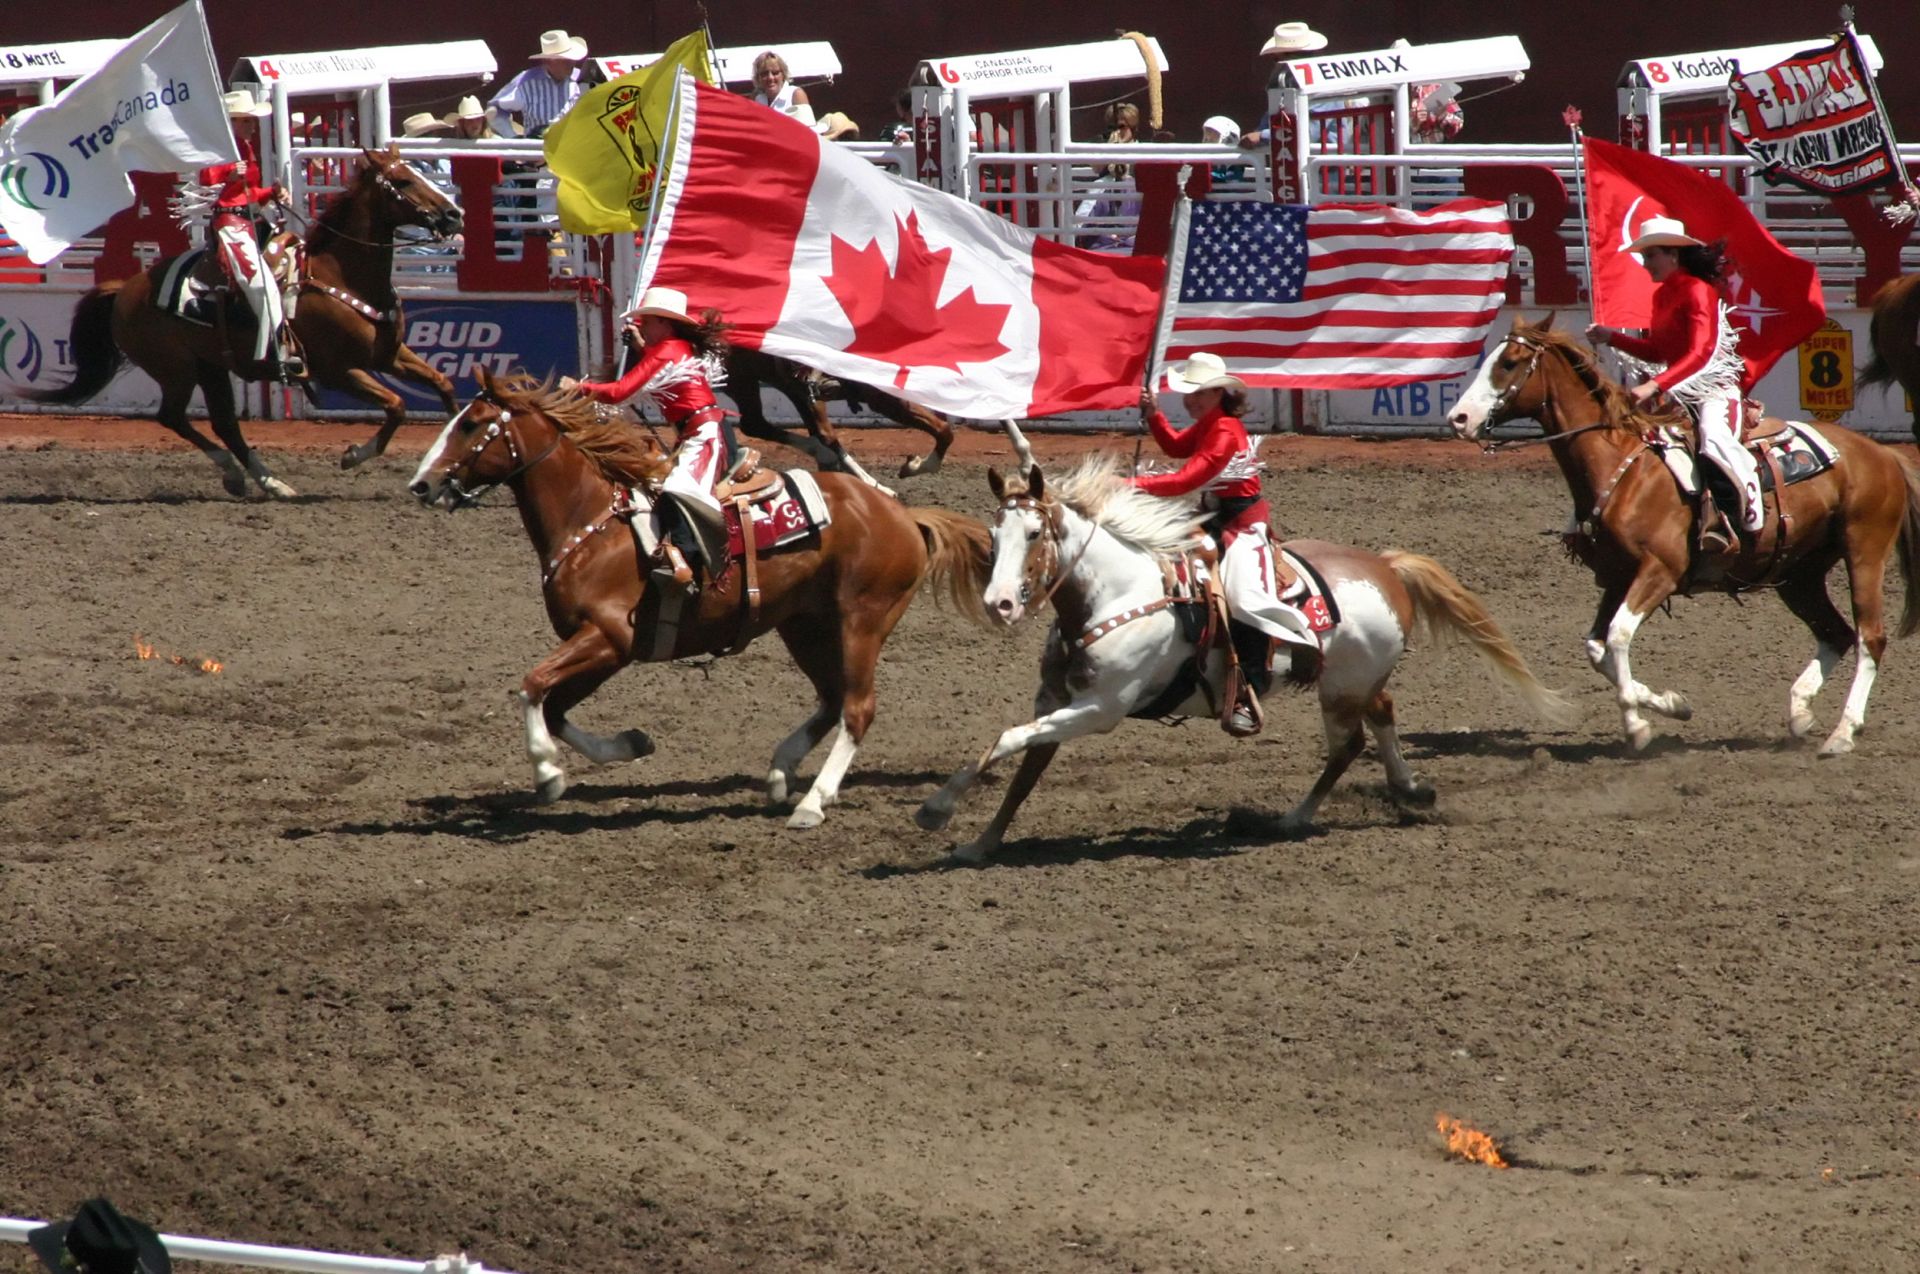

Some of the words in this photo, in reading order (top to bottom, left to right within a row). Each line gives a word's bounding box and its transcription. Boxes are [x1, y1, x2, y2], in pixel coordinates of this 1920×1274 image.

[6, 53, 23, 69] 8
[260, 60, 280, 80] 4
[605, 61, 627, 78] 5
[975, 56, 1033, 69] CANADIAN
[1294, 63, 1314, 85] 7
[1317, 55, 1408, 80] ENMAX
[1646, 62, 1670, 83] 8
[1672, 56, 1733, 79] Kodak
[940, 62, 961, 84] 6
[962, 69, 1013, 81] SUPERIOR
[1014, 64, 1054, 77] ENERGY
[406, 321, 502, 348] BUD
[1804, 337, 1847, 352] SUPER
[417, 352, 519, 378] GHT
[1809, 351, 1843, 388] 8
[1372, 383, 1430, 416] ATB
[1806, 388, 1851, 405] MOTEL
